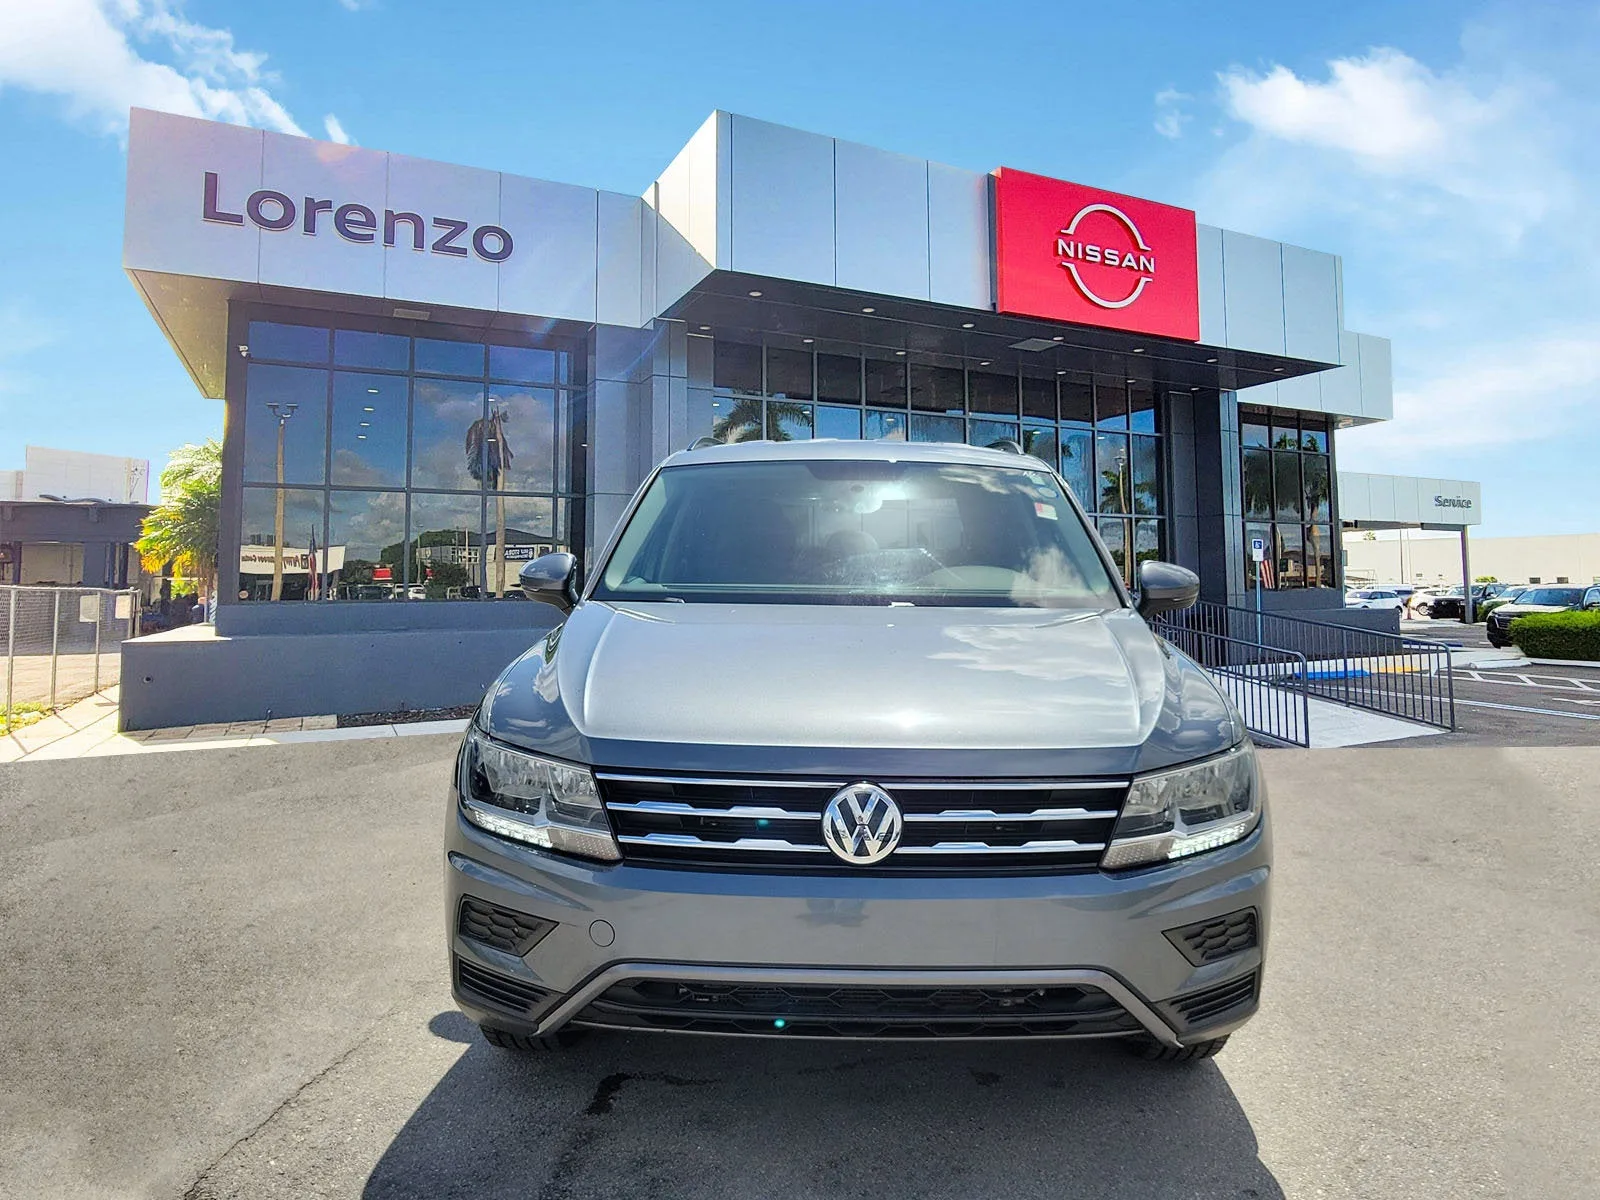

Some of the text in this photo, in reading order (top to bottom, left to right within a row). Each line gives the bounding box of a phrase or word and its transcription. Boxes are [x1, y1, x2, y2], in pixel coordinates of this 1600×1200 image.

[202, 171, 515, 262] Lorenzo
[1057, 238, 1155, 273] NISSAN
[1434, 495, 1472, 508] Service
[826, 786, 898, 862] VW
